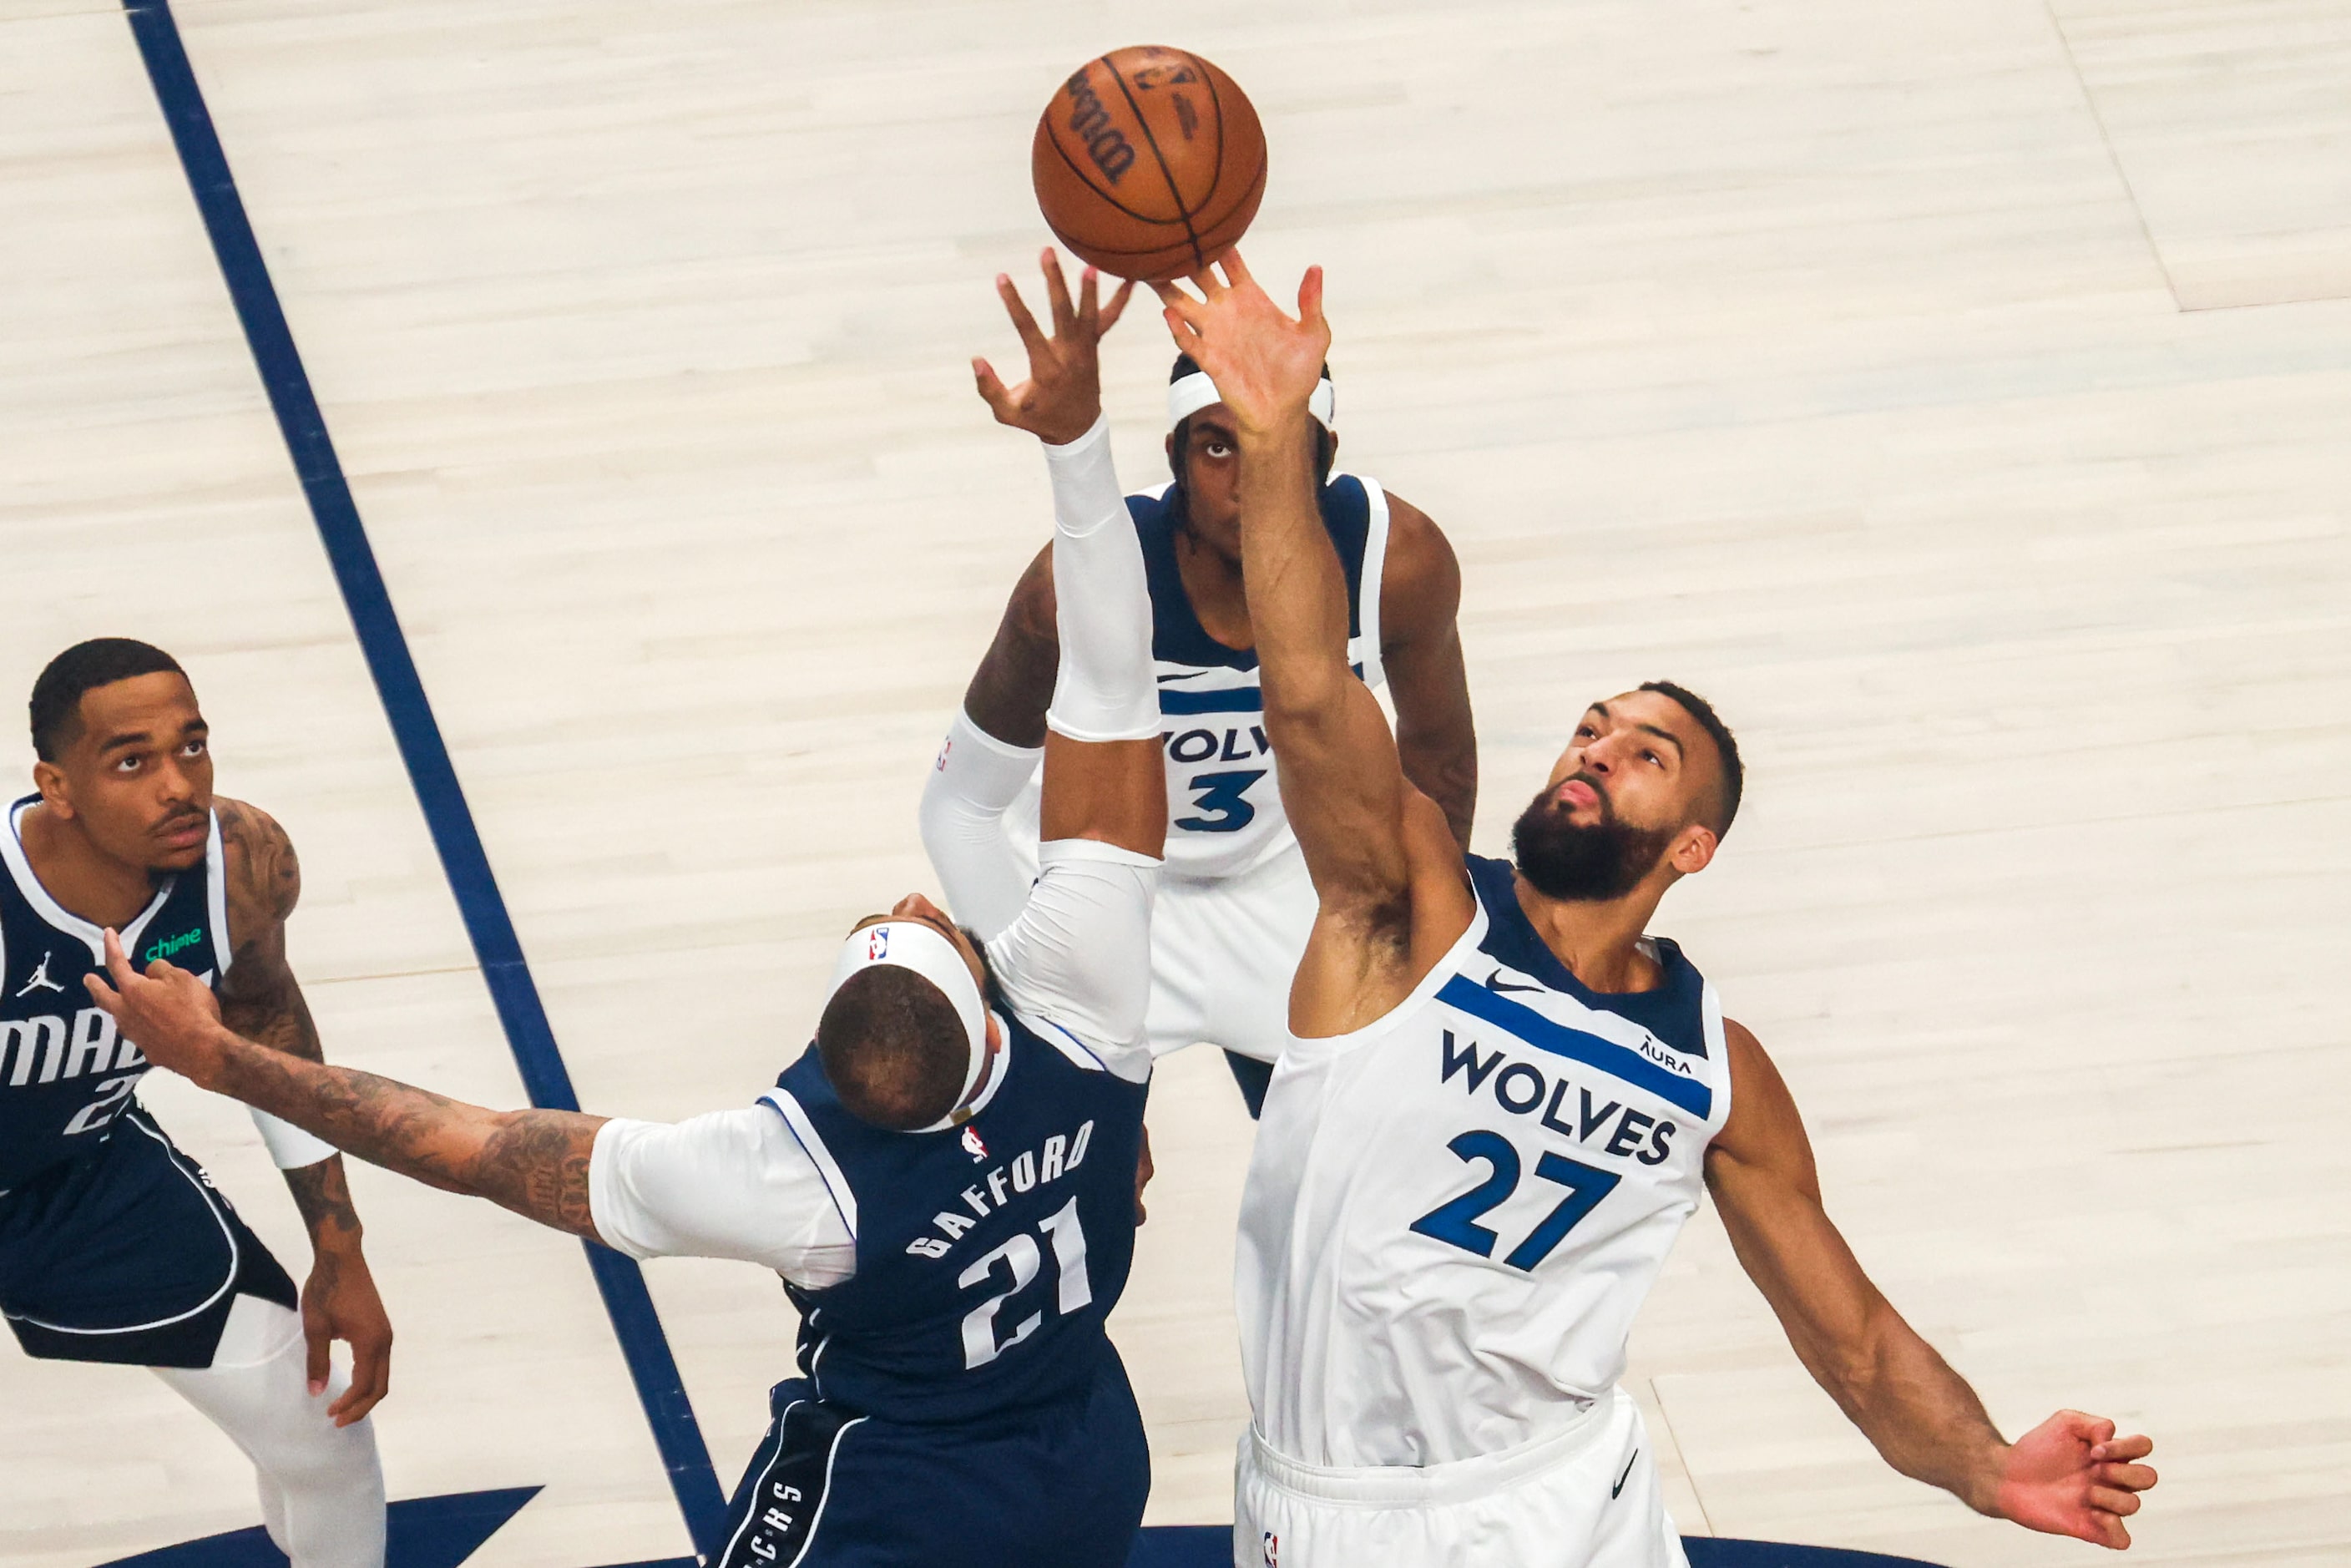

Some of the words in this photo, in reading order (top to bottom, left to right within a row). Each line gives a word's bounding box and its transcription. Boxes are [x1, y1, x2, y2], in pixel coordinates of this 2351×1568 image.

[1174, 769, 1268, 832] 3
[145, 928, 201, 963] chime
[1442, 1029, 1676, 1166] WOLVES
[906, 1120, 1094, 1258] GAFFORD
[1408, 1130, 1623, 1273] 27
[958, 1195, 1093, 1370] 21
